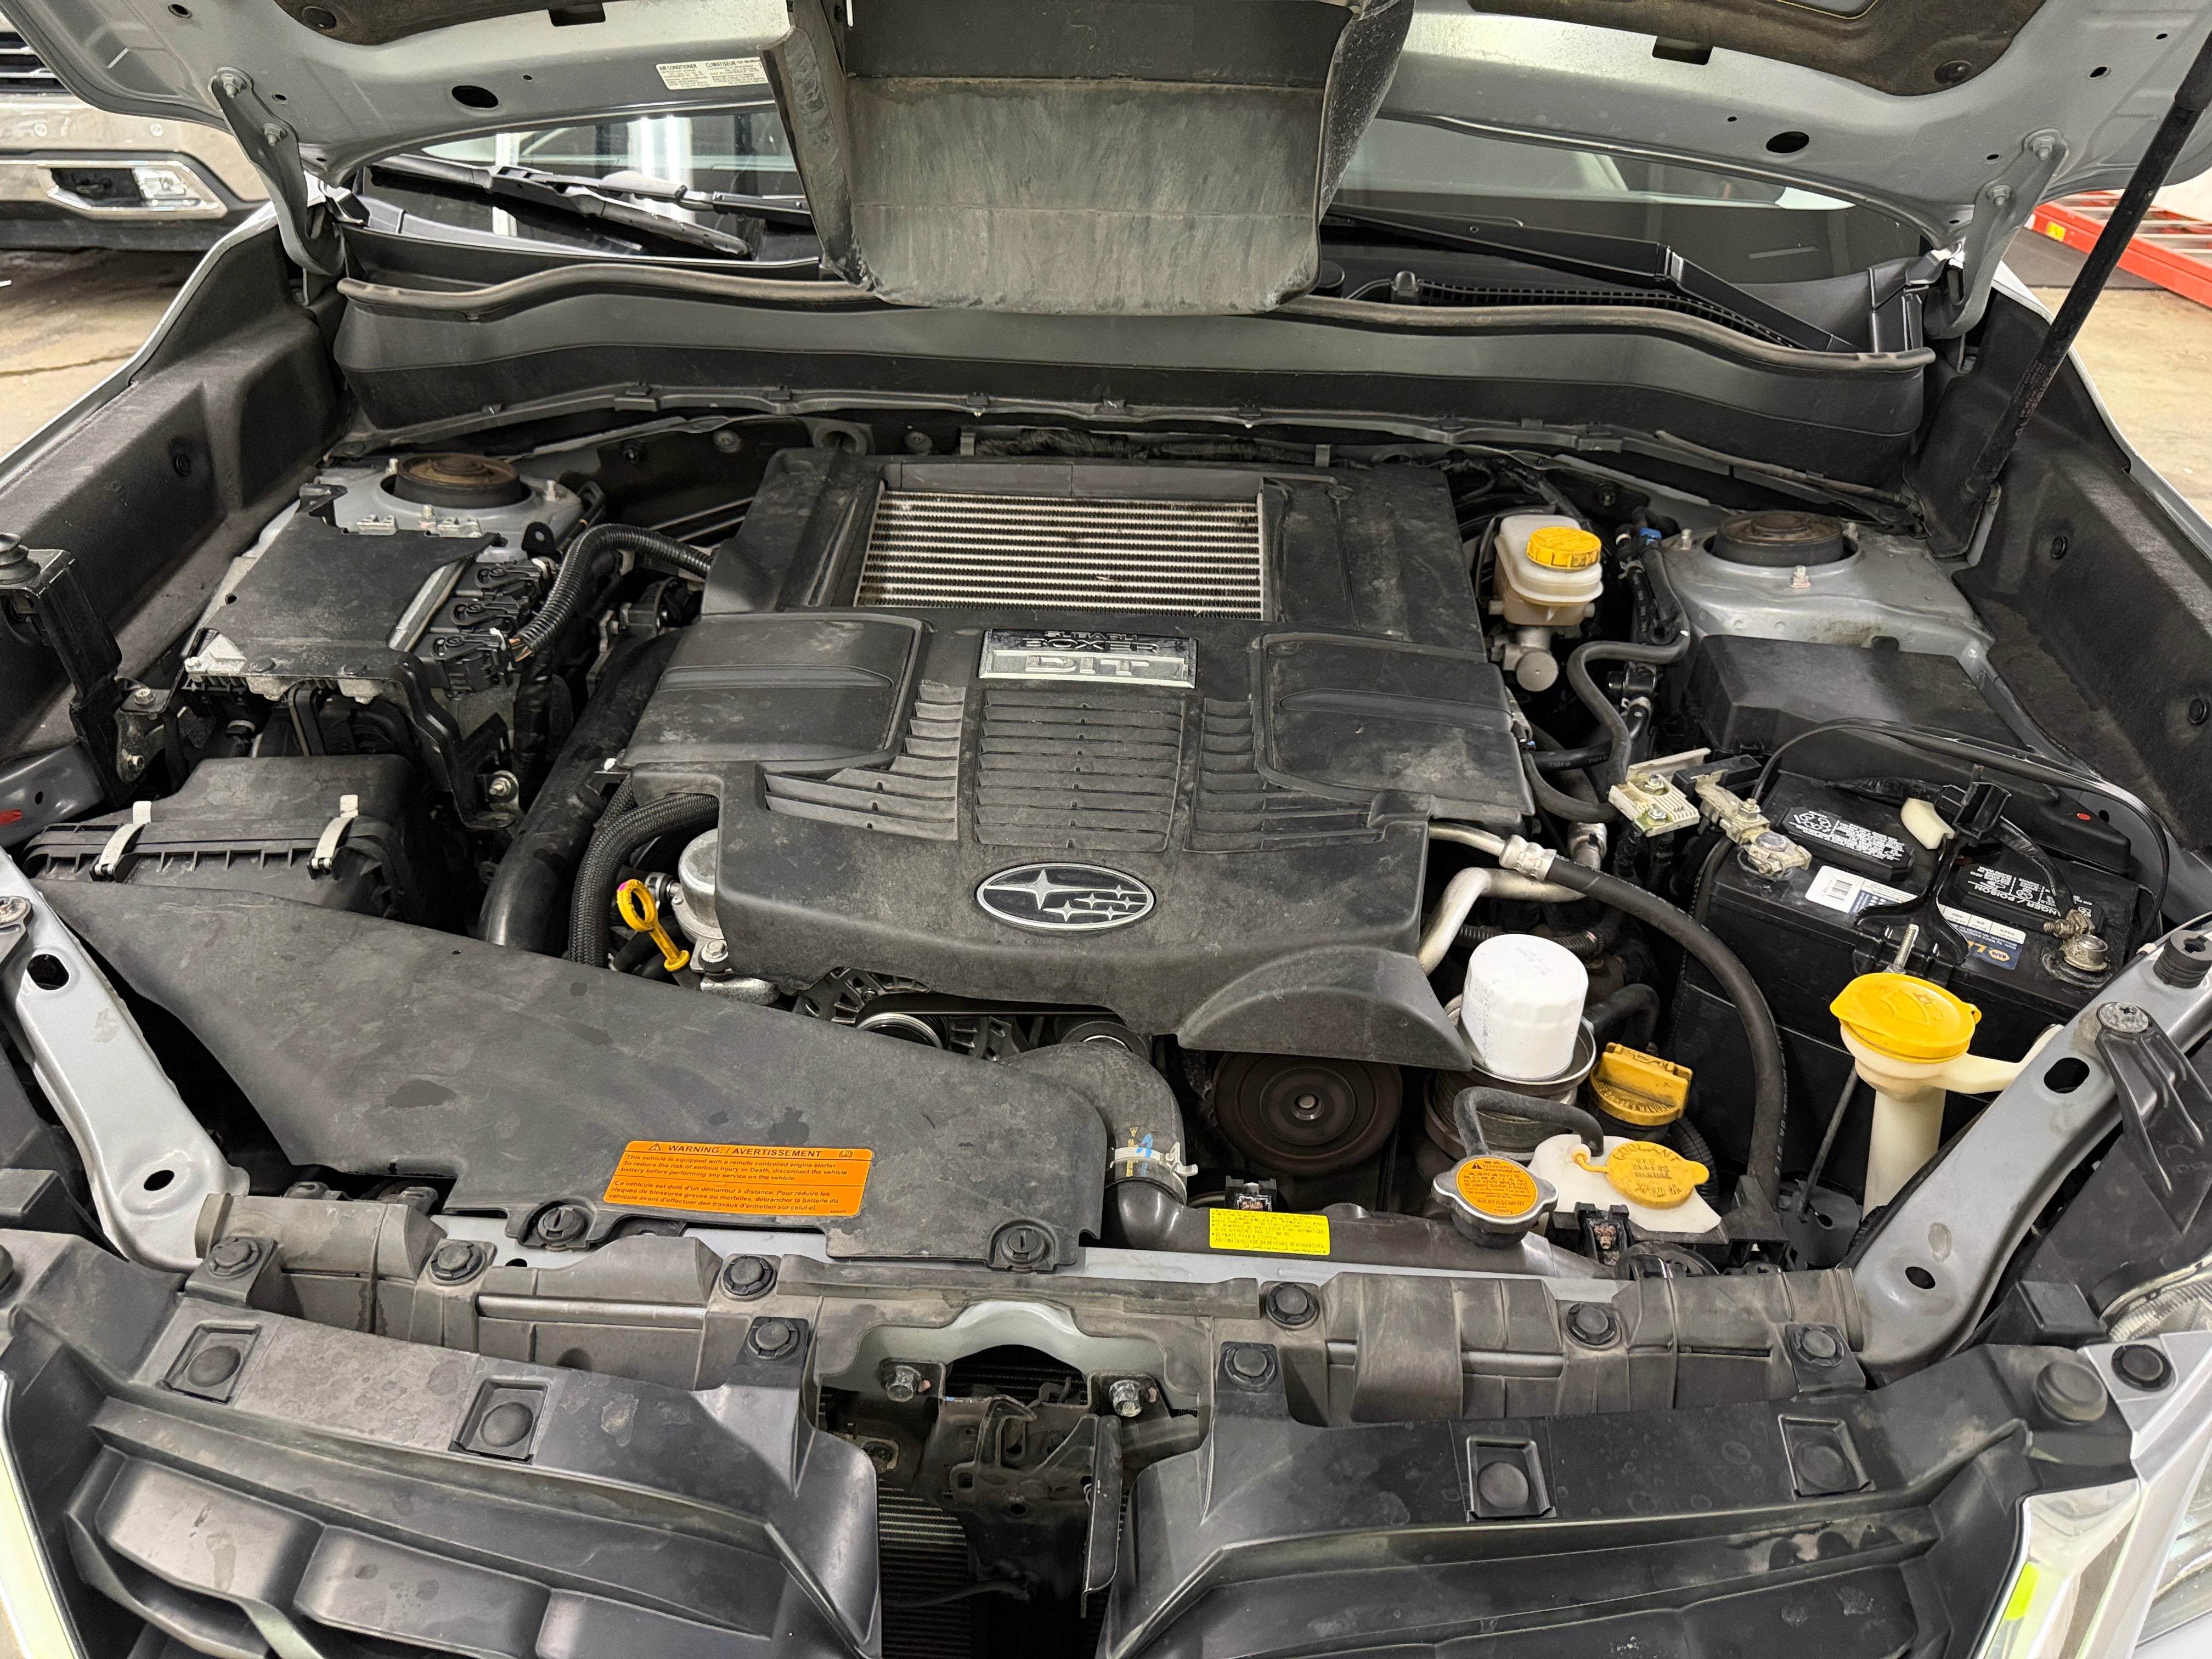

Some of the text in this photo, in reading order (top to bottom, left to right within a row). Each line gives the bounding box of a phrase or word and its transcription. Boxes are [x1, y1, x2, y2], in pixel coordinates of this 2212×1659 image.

[1044, 630, 1137, 640] SUBARU
[1023, 637, 1159, 653] BOXER
[1025, 654, 1150, 676] DIT
[1974, 884, 2016, 902] POISON
[1991, 951, 2007, 959] NAPA
[1613, 1143, 1681, 1161] COOLANT
